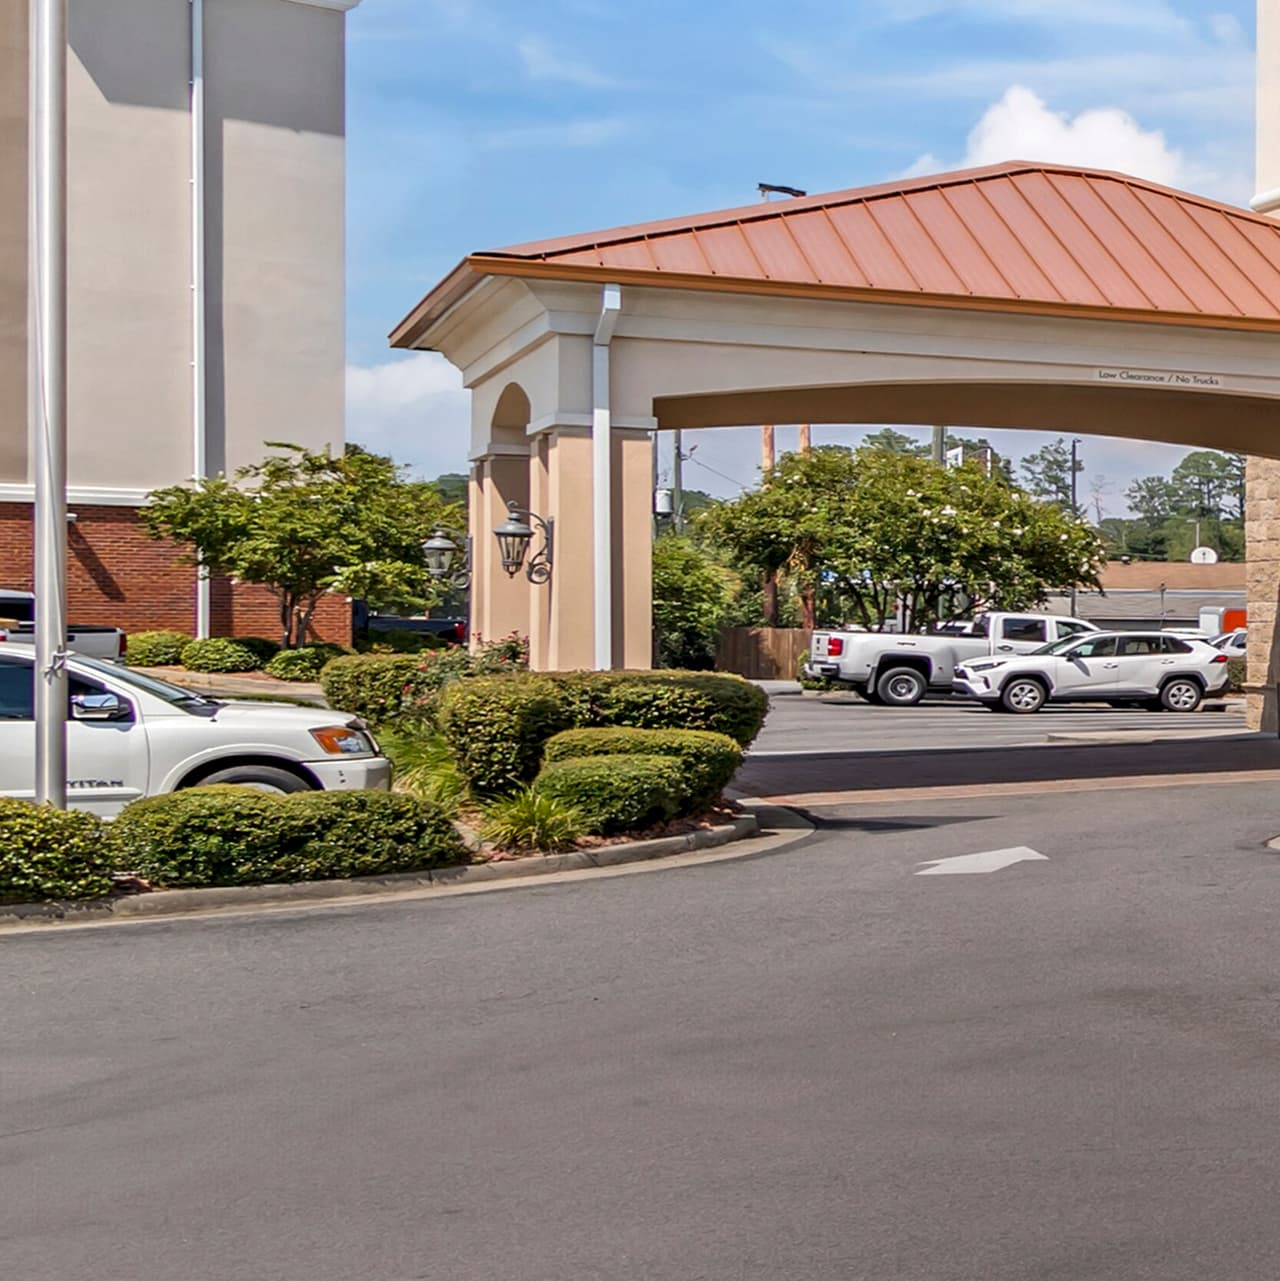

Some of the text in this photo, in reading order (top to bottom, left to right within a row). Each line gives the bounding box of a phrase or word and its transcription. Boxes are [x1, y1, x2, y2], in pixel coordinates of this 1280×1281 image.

[1099, 371, 1219, 385] Low Clearance / No Trucks
